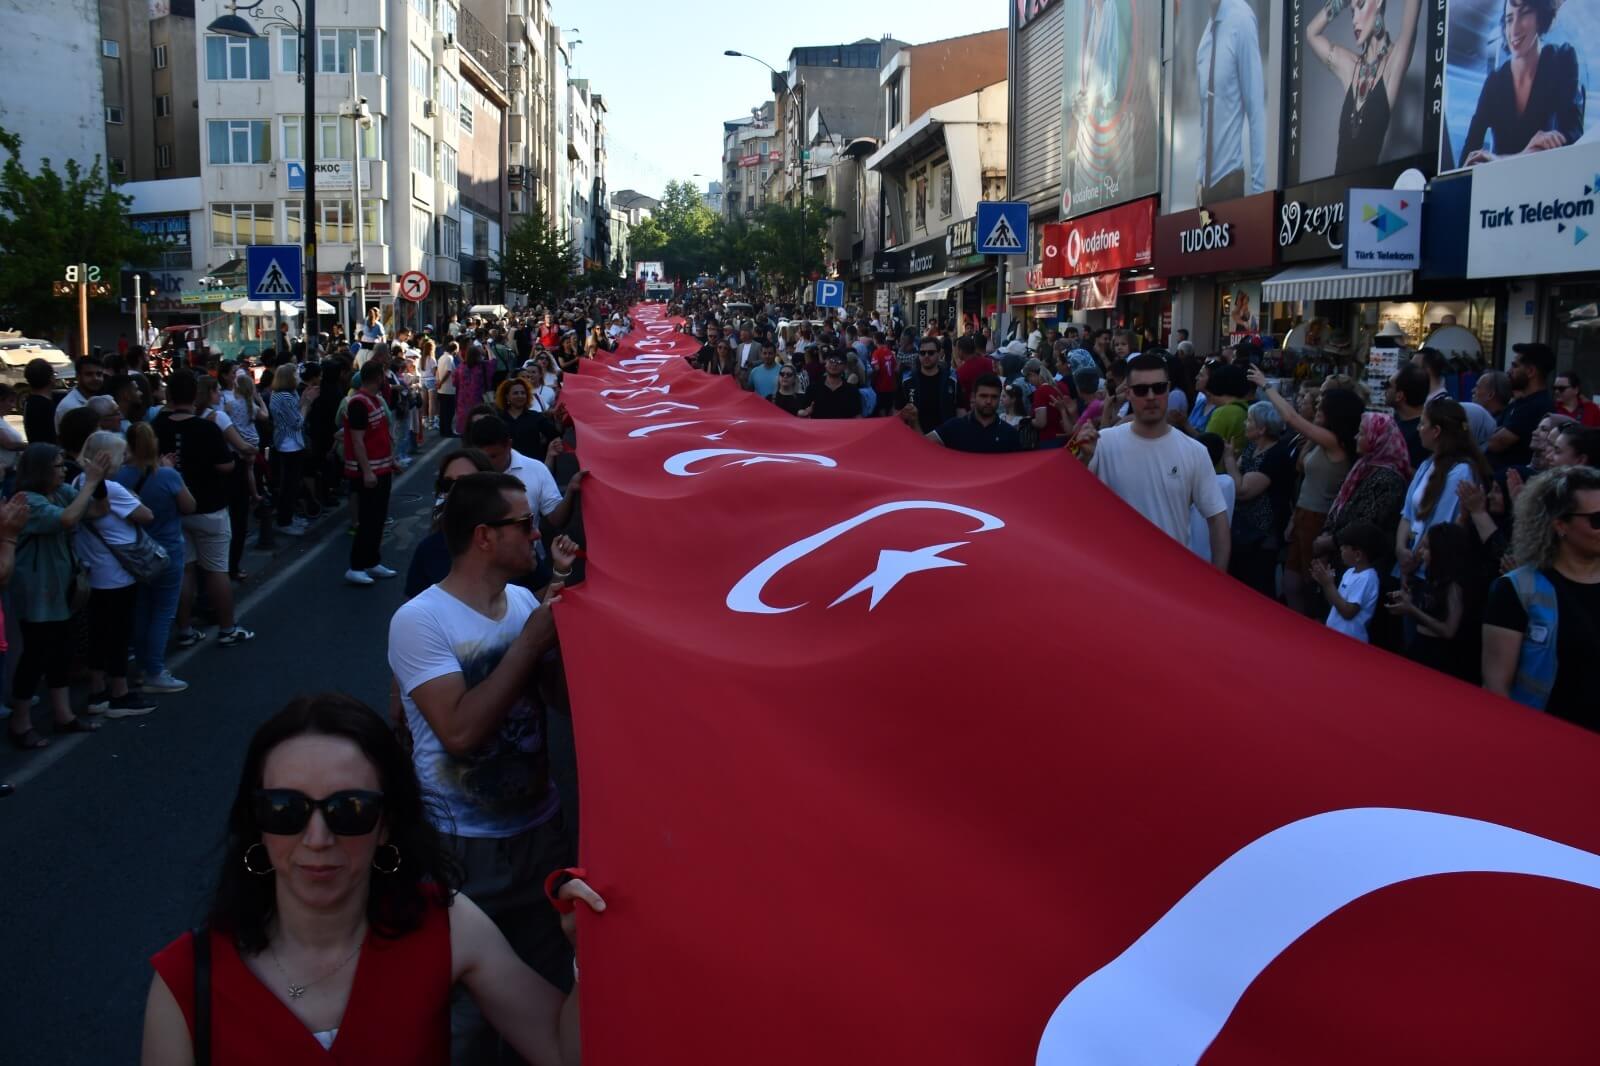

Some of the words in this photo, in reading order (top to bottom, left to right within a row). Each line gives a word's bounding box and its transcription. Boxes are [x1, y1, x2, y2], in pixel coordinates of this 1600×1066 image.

[1432, 0, 1445, 114] ESUAR
[1291, 91, 1299, 156] TAKI
[314, 164, 341, 175] RKOÇ
[1072, 185, 1099, 204] vodafone
[1104, 175, 1120, 198] Red
[1304, 201, 1344, 249] zeyn
[1480, 206, 1514, 229] Türk
[1519, 198, 1594, 224] Telekom
[1081, 227, 1120, 255] vodafone
[1180, 222, 1230, 254] TUDORS
[1355, 250, 1375, 260] Türk
[1377, 250, 1415, 261] Telekom
[822, 283, 838, 305] P
